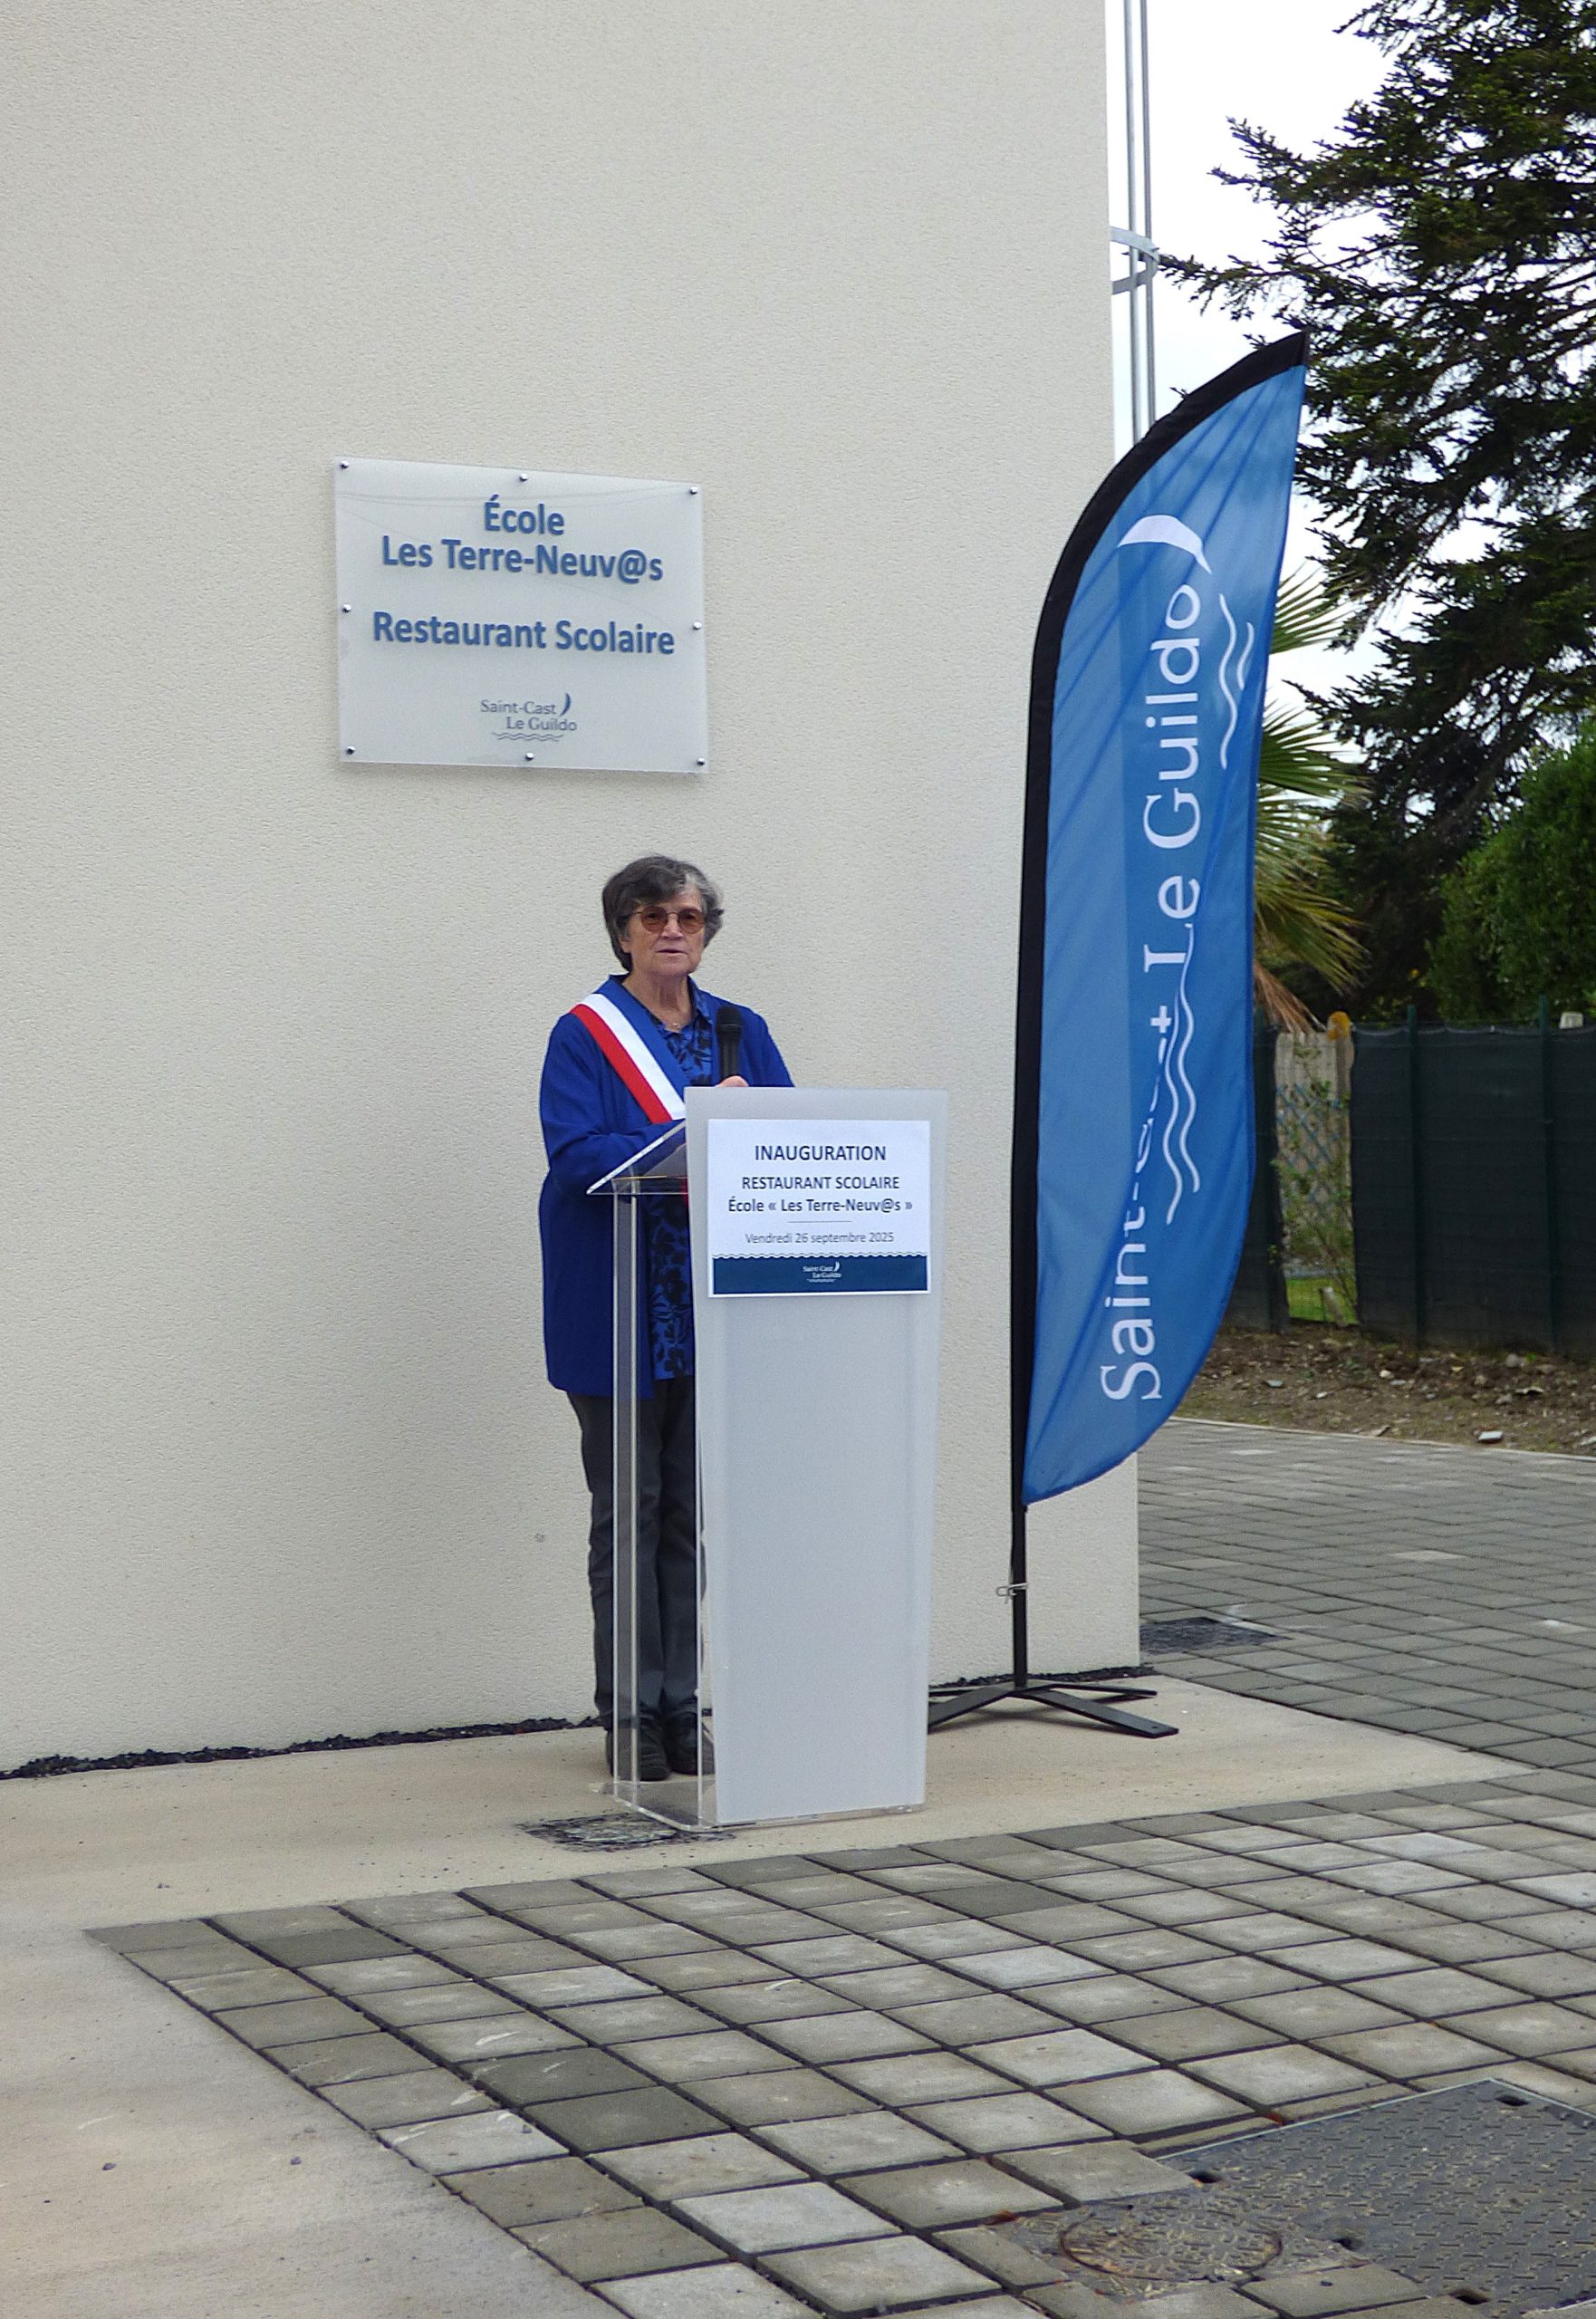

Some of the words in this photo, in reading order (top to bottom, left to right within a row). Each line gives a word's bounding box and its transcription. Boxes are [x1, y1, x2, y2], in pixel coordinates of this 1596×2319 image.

[484, 494, 565, 536] École
[381, 535, 433, 568] Les
[441, 538, 664, 584] Terre-Neuv@s
[372, 611, 547, 650] Restaurant
[554, 620, 676, 655] Scolaire
[480, 698, 557, 715] Saint-Cast
[505, 716, 524, 730] Le
[528, 717, 578, 731] Guildo
[1143, 584, 1202, 850] Guildo
[755, 1144, 887, 1162] INAUGURATION
[742, 1176, 832, 1189] RESTAURANT
[835, 1176, 900, 1189] SCOLAIRE
[727, 1196, 764, 1212] École
[780, 1198, 803, 1212] Les
[807, 1198, 900, 1213] Terre-Neuv@s
[745, 1233, 793, 1244] Vendredi
[794, 1233, 809, 1244] 26
[811, 1233, 866, 1246] septembre
[869, 1231, 895, 1243] 2025
